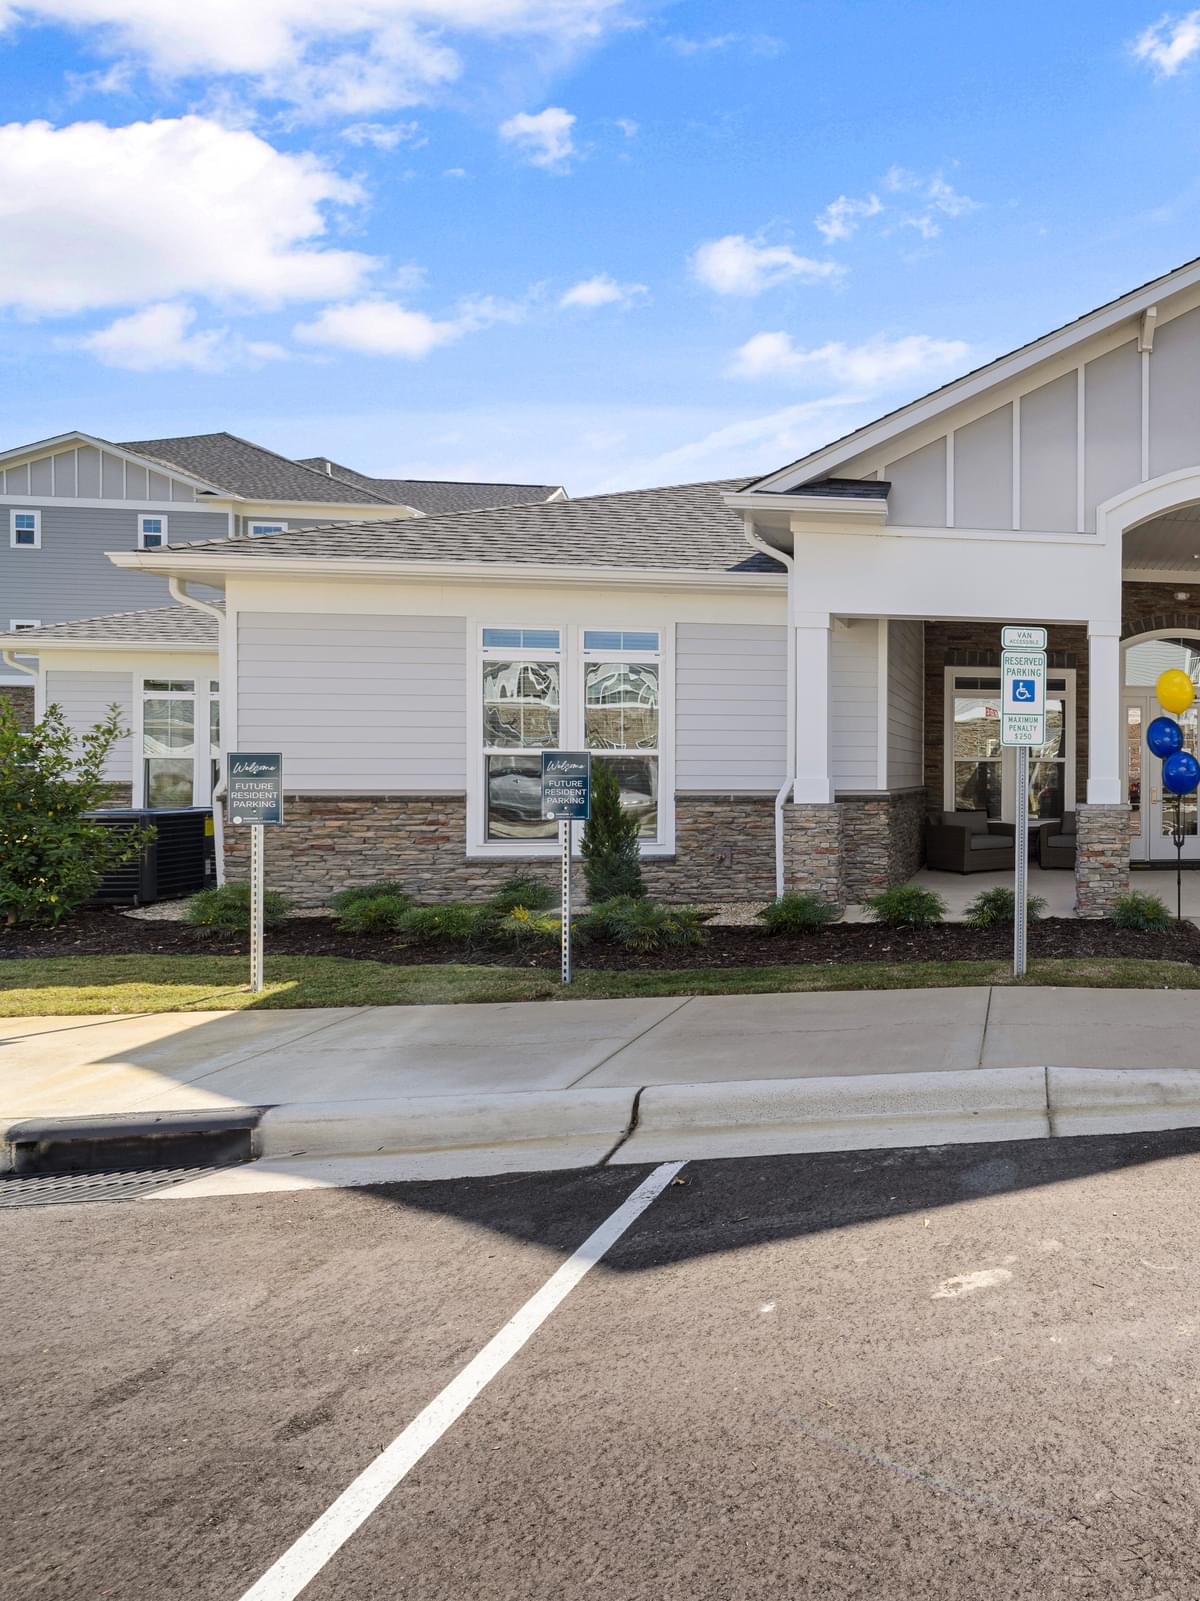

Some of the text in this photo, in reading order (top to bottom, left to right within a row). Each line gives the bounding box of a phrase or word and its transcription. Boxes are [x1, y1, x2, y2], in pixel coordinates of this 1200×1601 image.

[1004, 656, 1043, 666] RESERVED
[1006, 667, 1041, 677] PARKING
[233, 761, 277, 774] Welcome
[549, 780, 583, 788] FUTURE
[231, 791, 278, 799] RESIDENT
[233, 800, 276, 808] PARKING
[547, 797, 584, 805] PARKING
